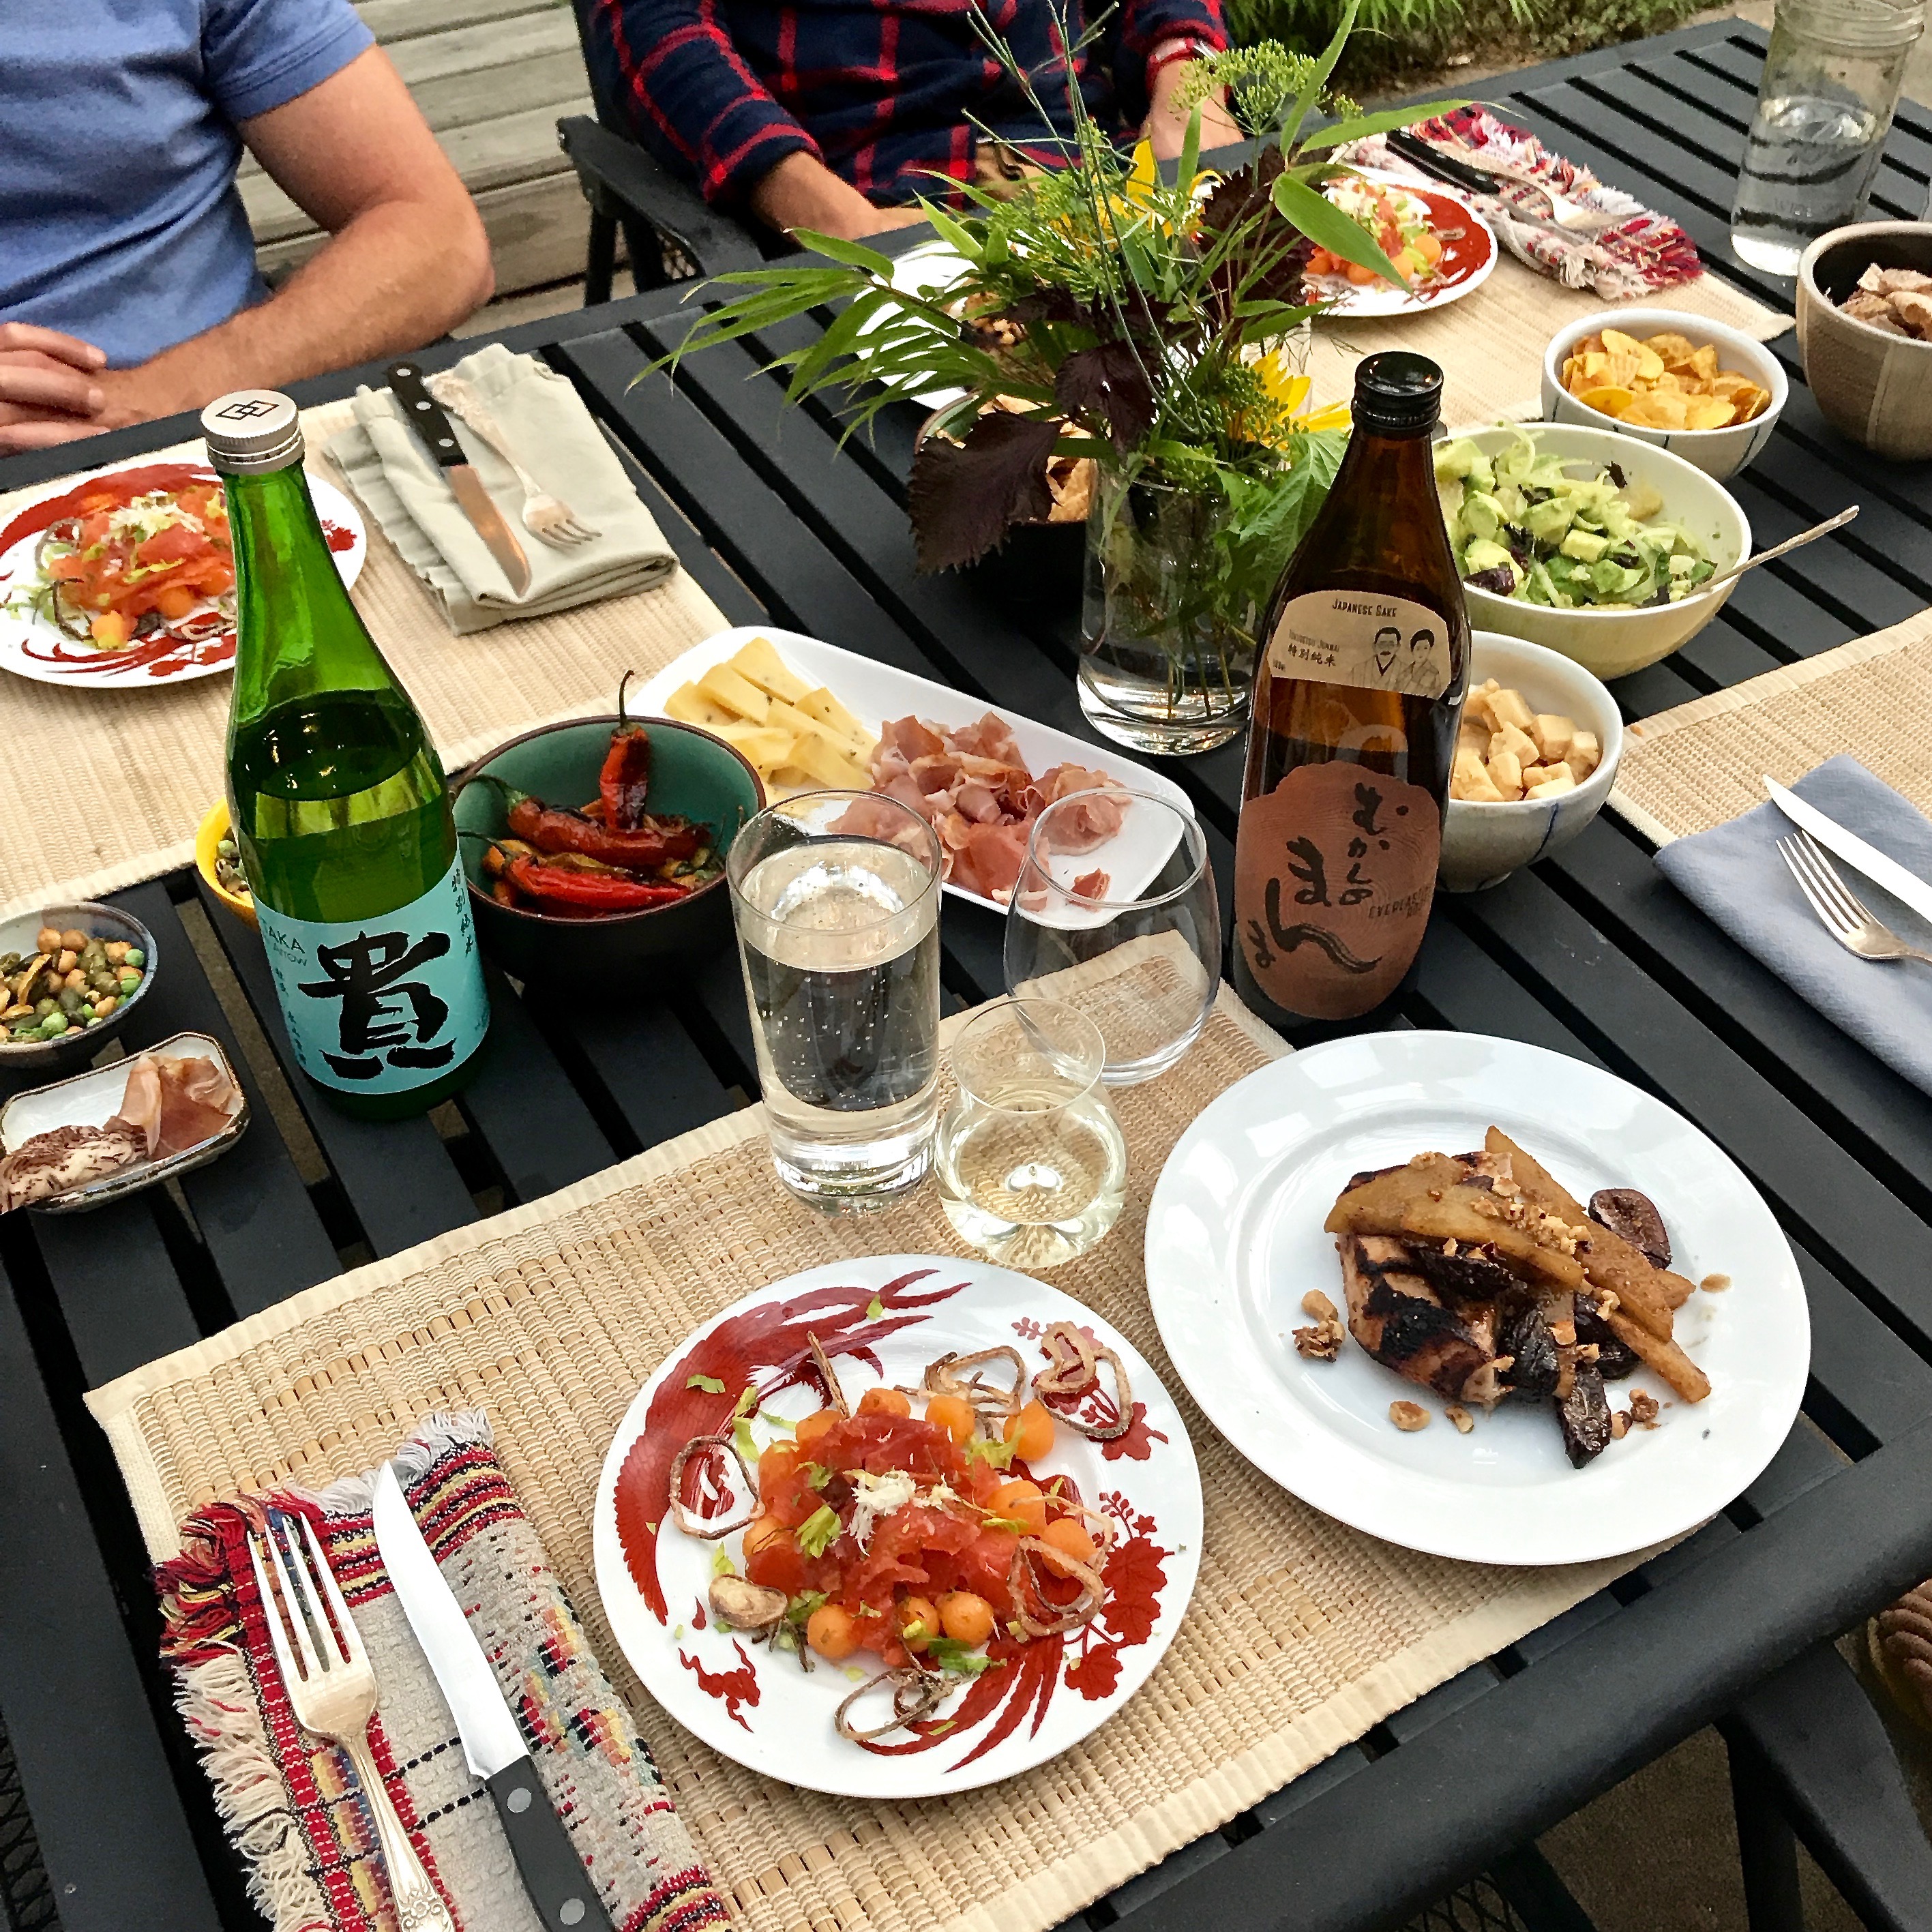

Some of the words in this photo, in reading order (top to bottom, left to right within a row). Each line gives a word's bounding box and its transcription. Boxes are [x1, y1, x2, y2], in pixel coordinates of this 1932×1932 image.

[1332, 598, 1373, 616] JAPANESE
[1376, 604, 1397, 618] SAKE
[297, 930, 458, 1080] 貴
